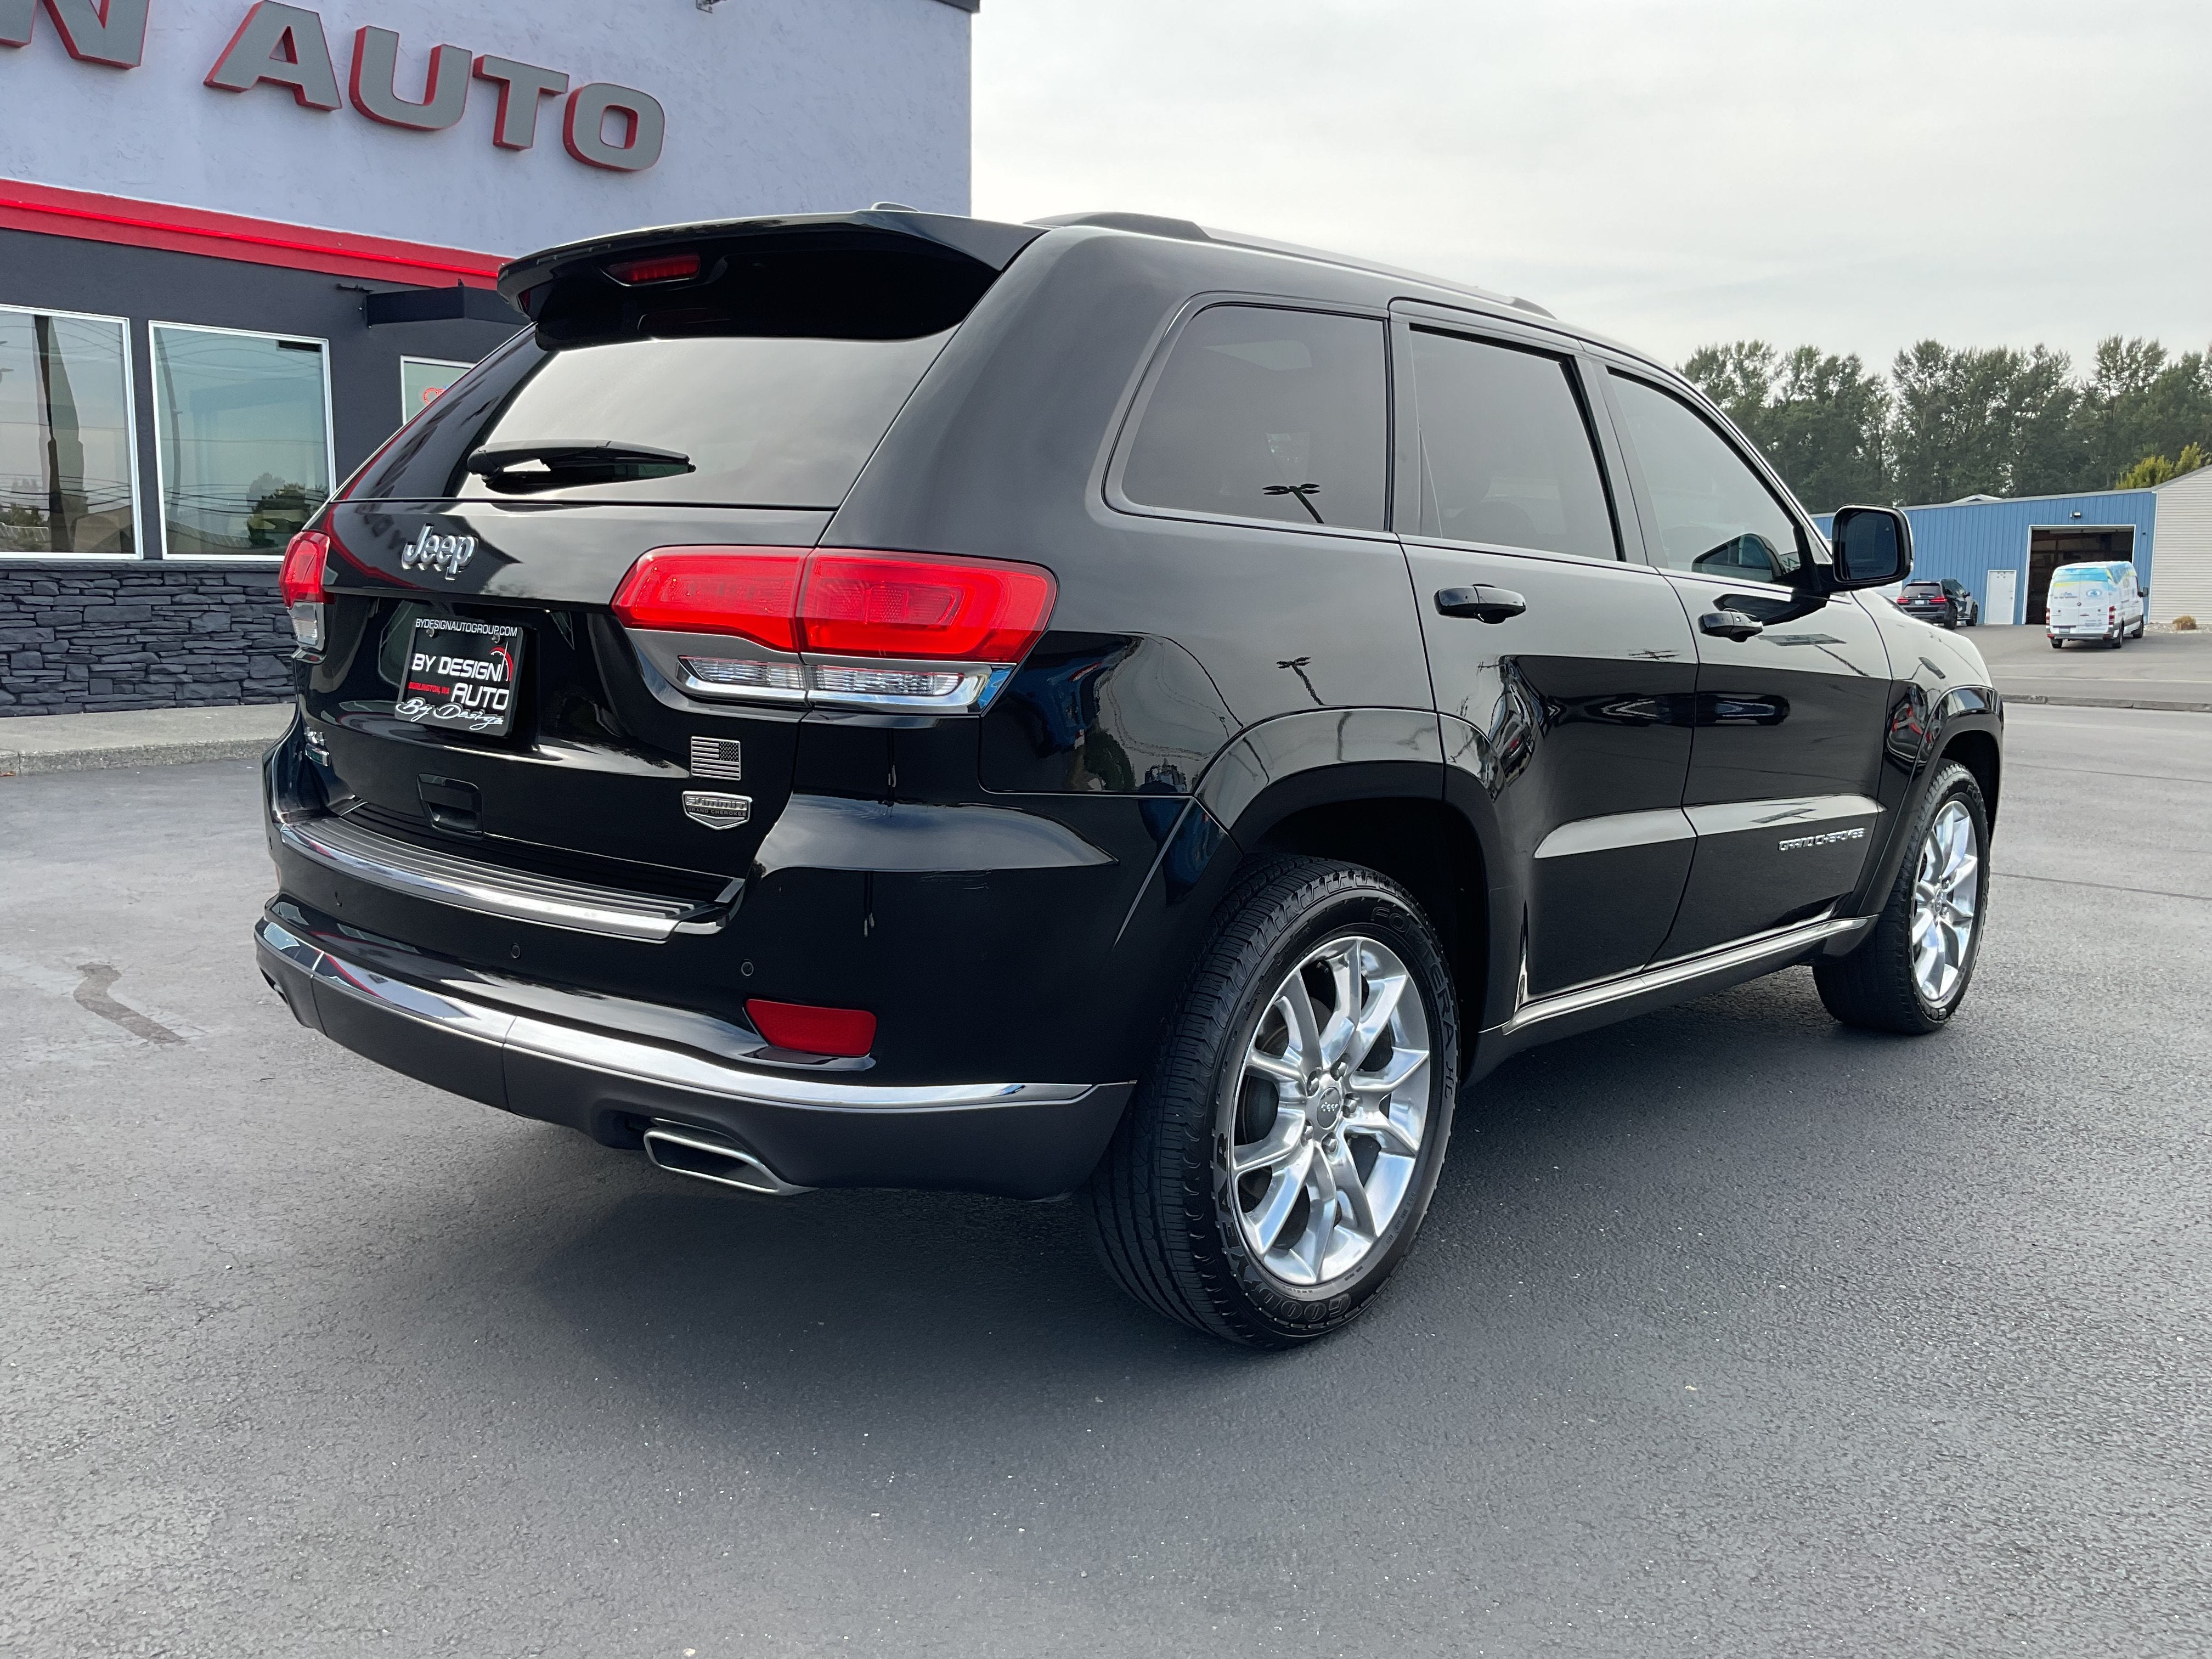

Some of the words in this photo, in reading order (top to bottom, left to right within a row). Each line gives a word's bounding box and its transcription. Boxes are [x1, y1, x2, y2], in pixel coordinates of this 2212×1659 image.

[203, 0, 665, 172] AUTO
[402, 523, 479, 581] Jeep
[415, 618, 517, 637] BYDESIGNAUTOGROUP.COM
[411, 653, 437, 672] BY
[438, 656, 501, 682] DESIGN
[450, 682, 510, 710] AUTO
[396, 698, 433, 722] By
[433, 704, 504, 730] Design
